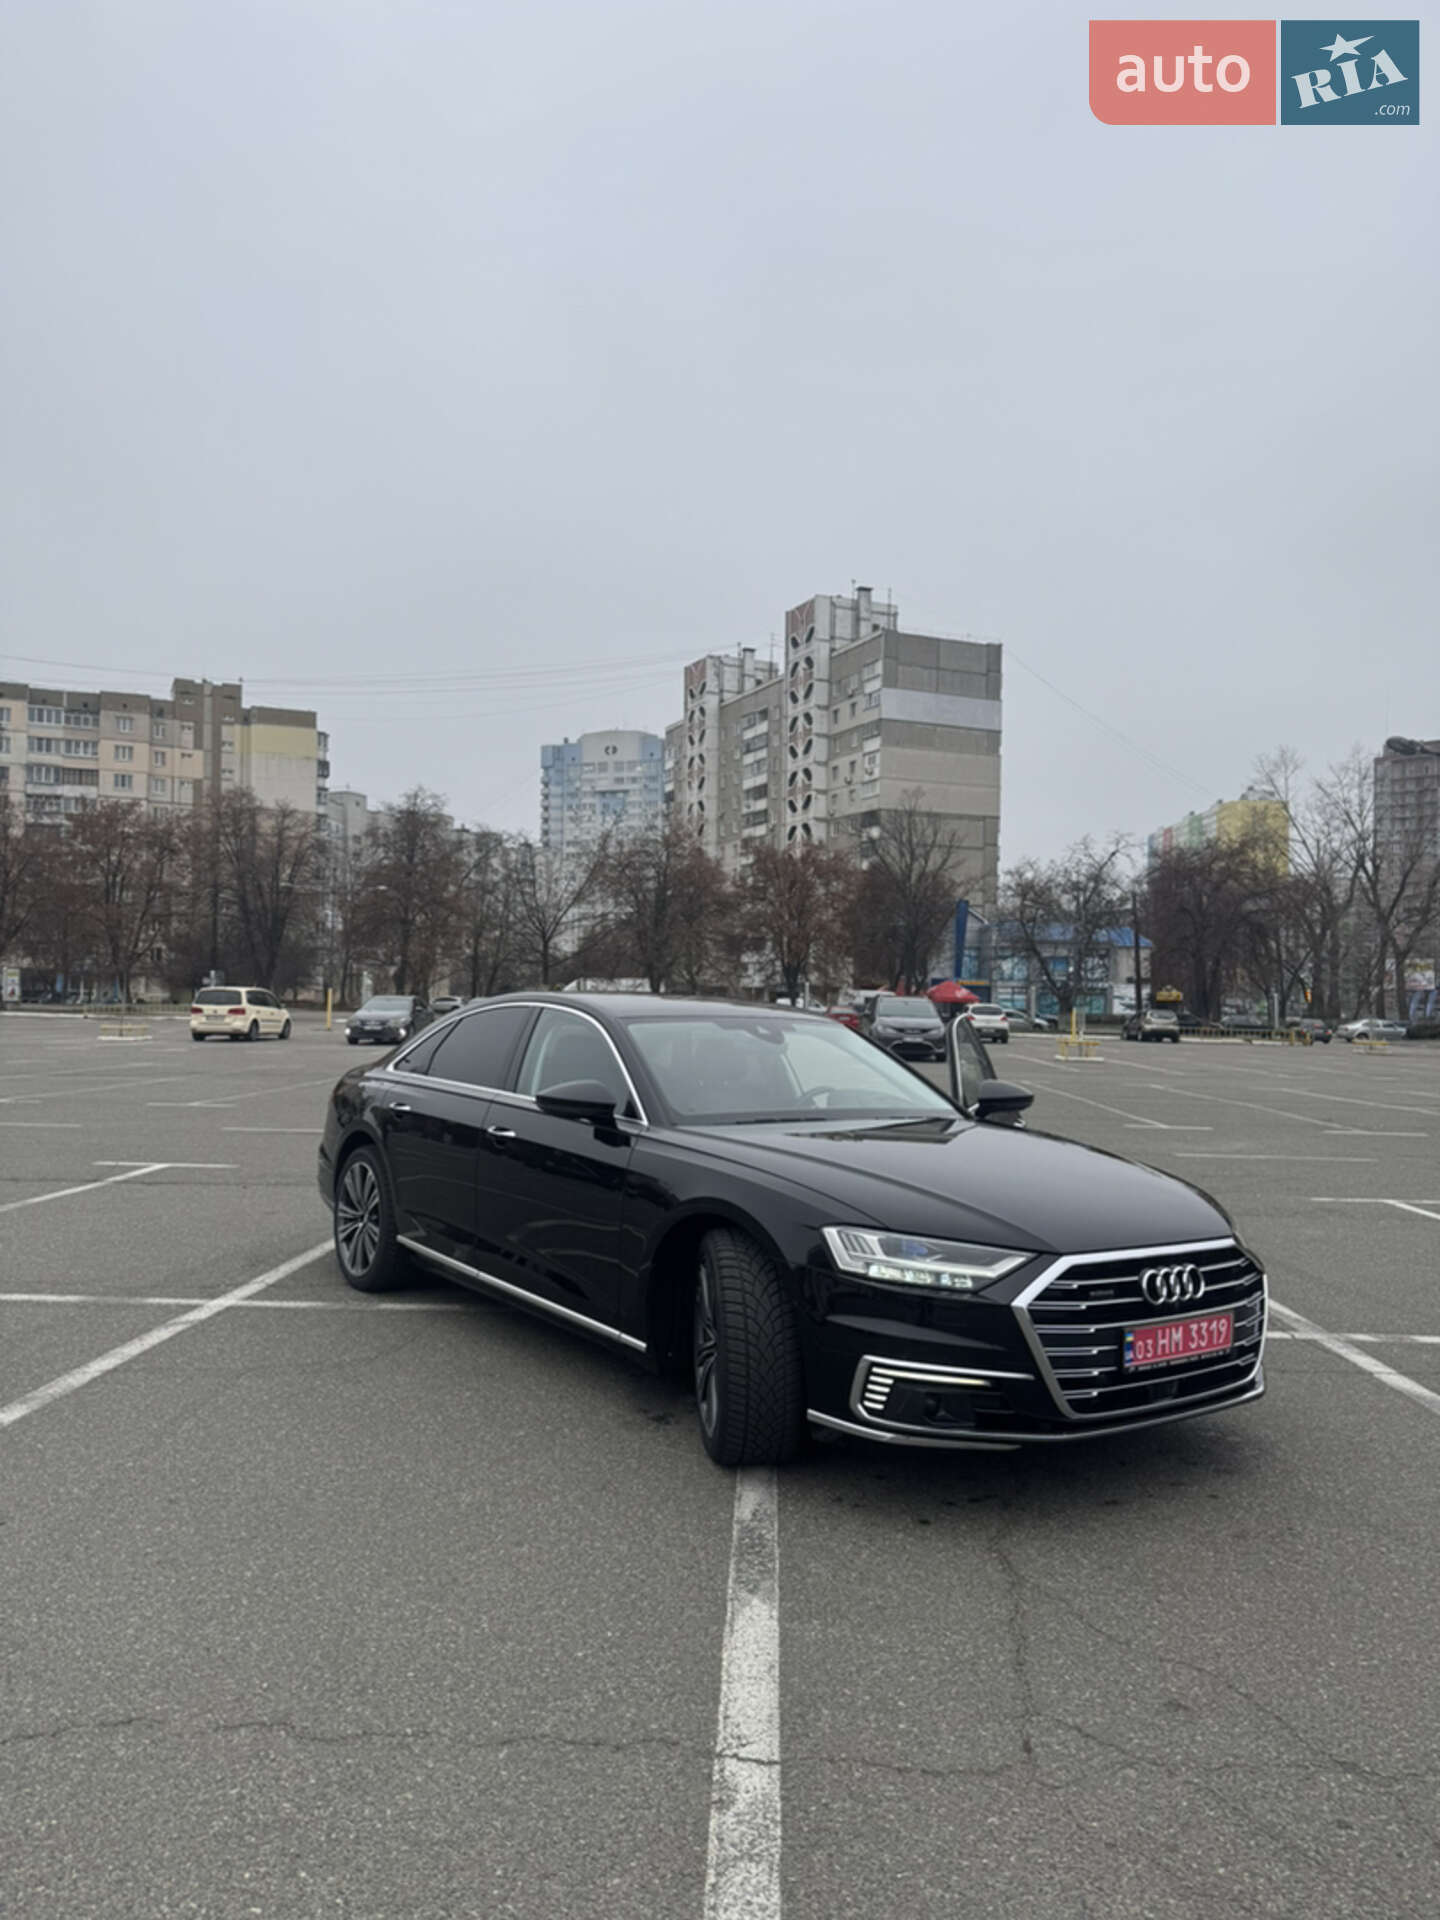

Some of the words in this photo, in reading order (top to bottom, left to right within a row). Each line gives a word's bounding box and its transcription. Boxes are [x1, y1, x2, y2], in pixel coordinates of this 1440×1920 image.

[1135, 1339, 1153, 1360] 03
[1157, 1325, 1184, 1356] HM
[1189, 1318, 1229, 1350] 3319
